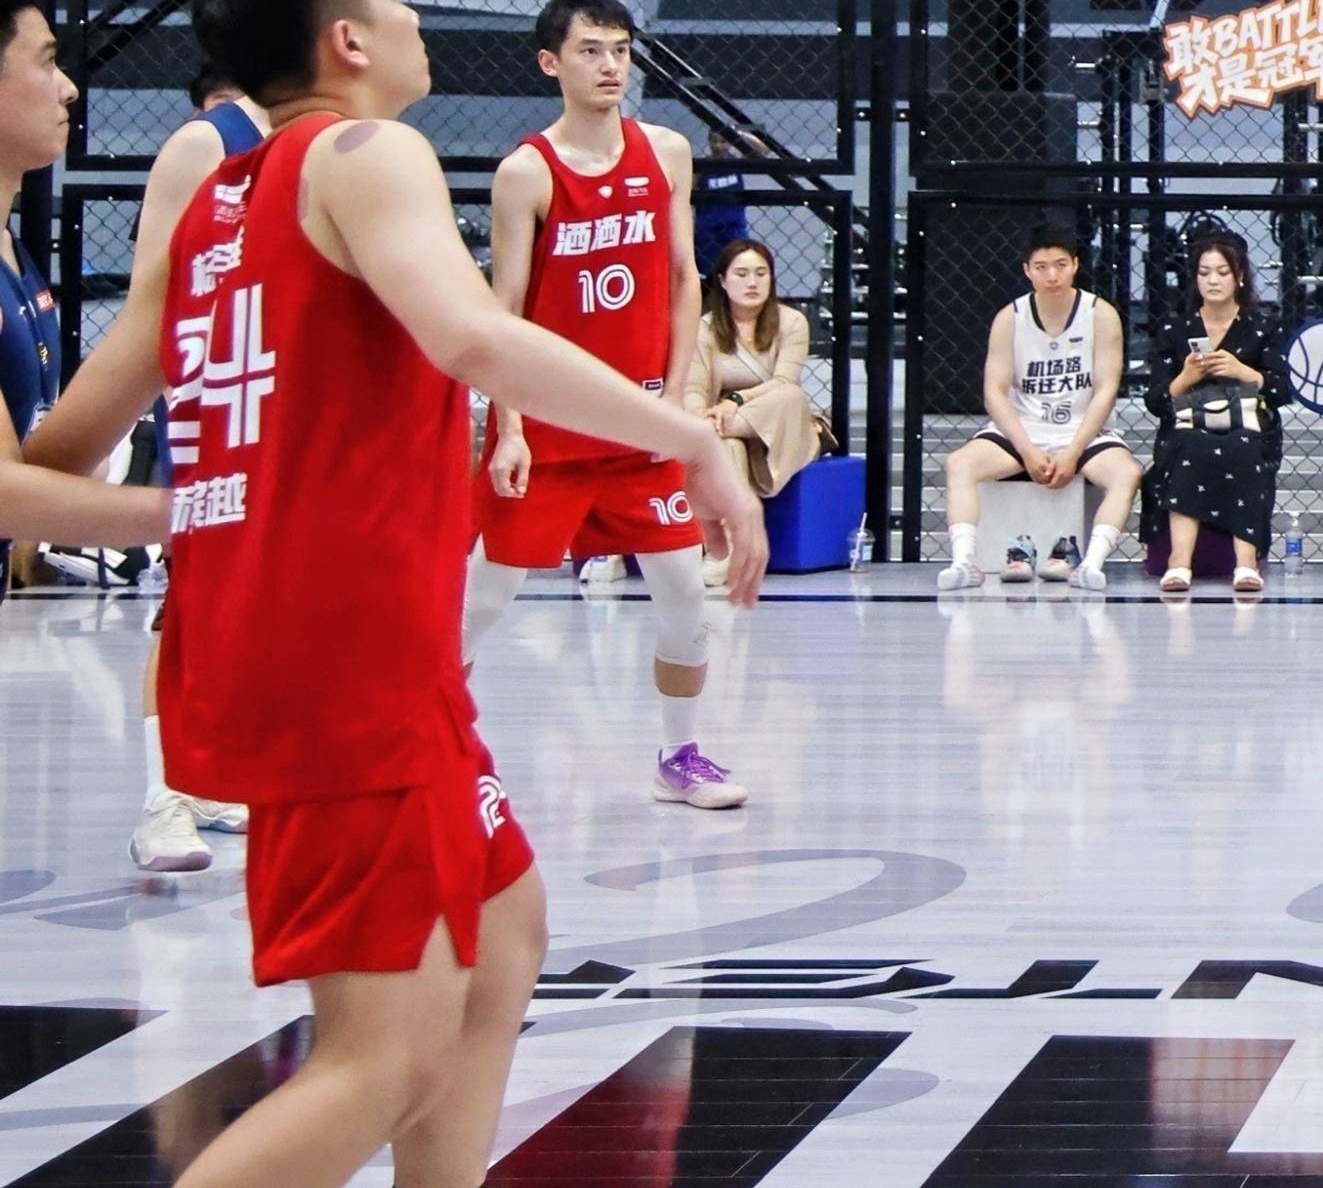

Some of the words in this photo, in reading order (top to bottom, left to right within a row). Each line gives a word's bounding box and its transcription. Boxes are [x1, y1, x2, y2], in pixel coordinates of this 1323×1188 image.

[580, 263, 635, 313] 10
[168, 283, 276, 464] 24
[1022, 372, 1093, 395] 拆迁大队
[1026, 355, 1082, 378] 机场路
[649, 491, 693, 525] 10
